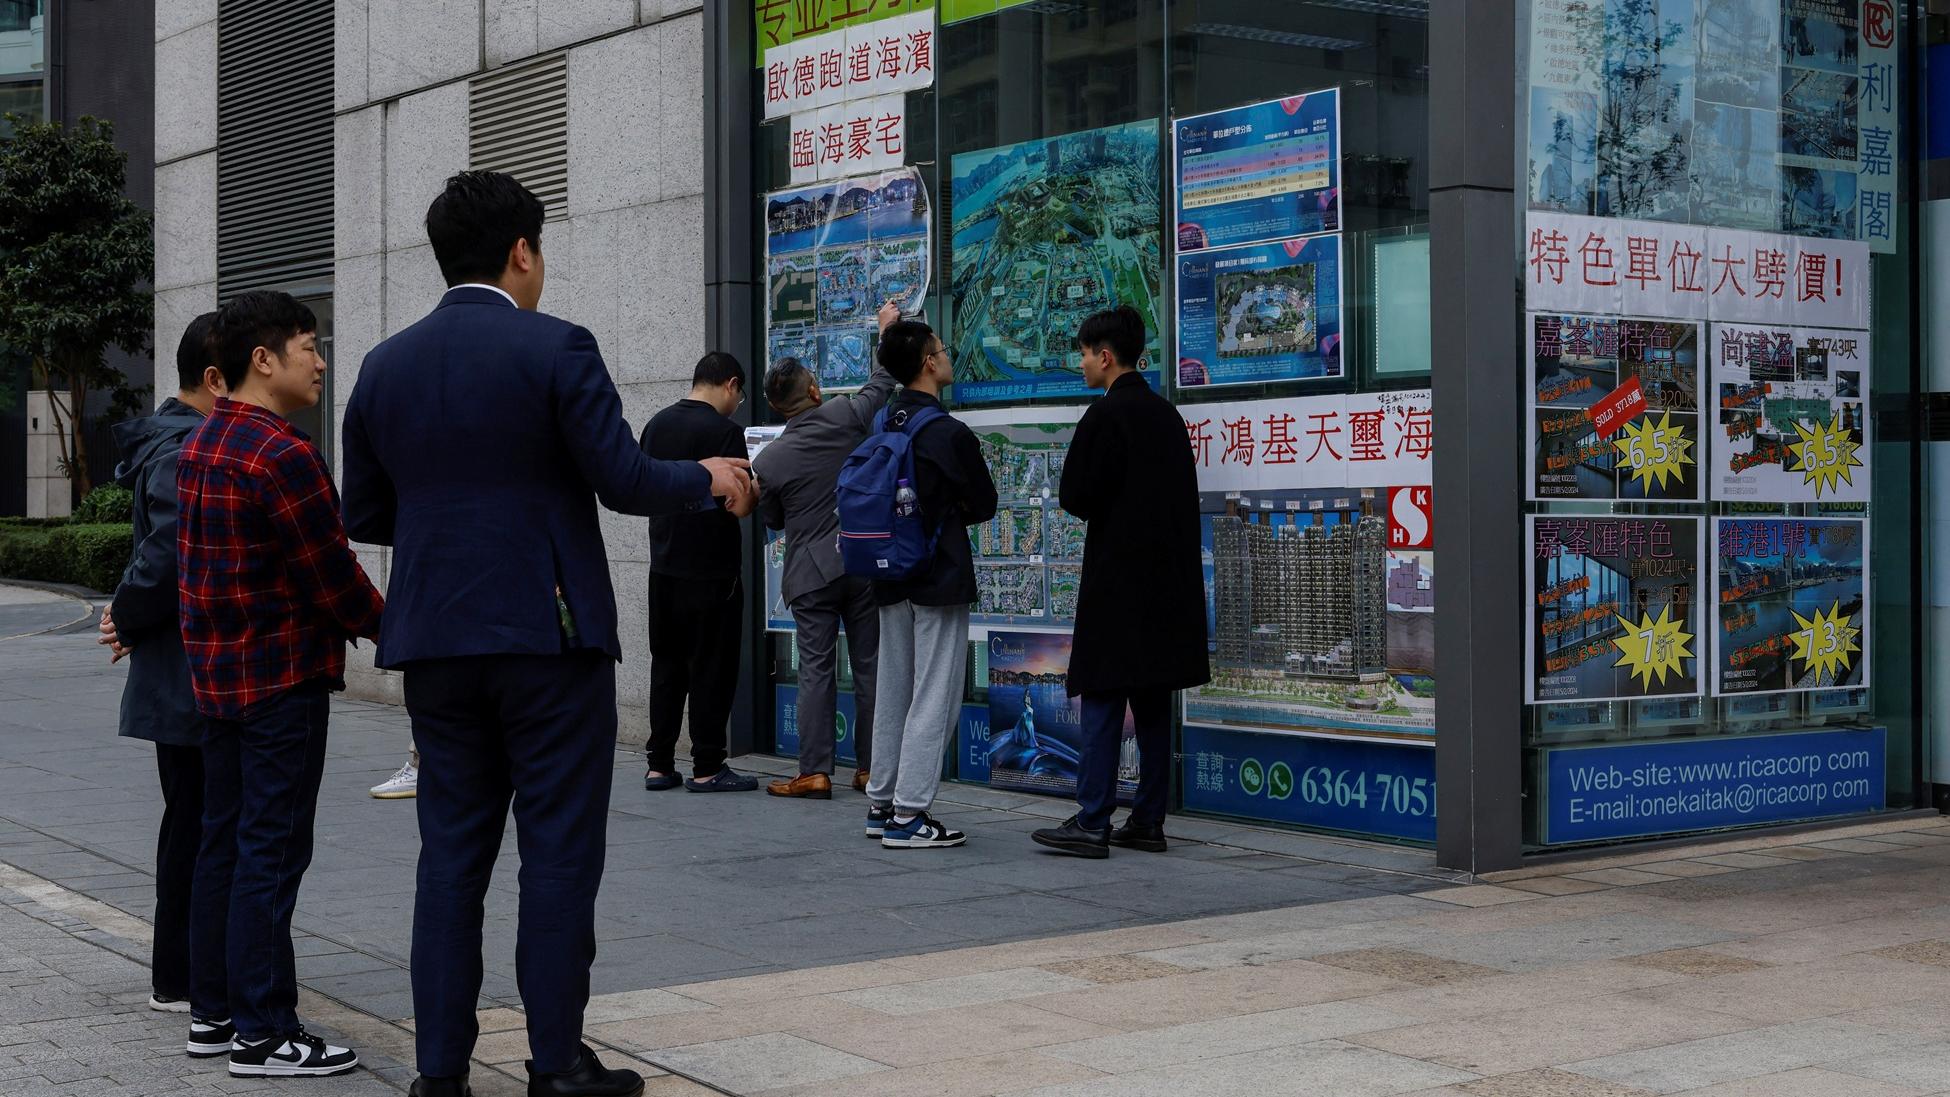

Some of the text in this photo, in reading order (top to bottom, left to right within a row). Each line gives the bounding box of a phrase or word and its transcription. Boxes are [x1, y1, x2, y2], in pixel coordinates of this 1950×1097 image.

[768, 30, 930, 103] 啟德跑道海濱
[793, 112, 902, 169] 臨海豪宅
[1859, 62, 1892, 241] 利嘉閣
[1529, 228, 1843, 302] 特色單位大劈價!
[1595, 409, 1615, 428] SOLD
[1720, 521, 1806, 559] 維港1號
[1639, 629, 1676, 664] 7折
[1302, 766, 1367, 809] 6364
